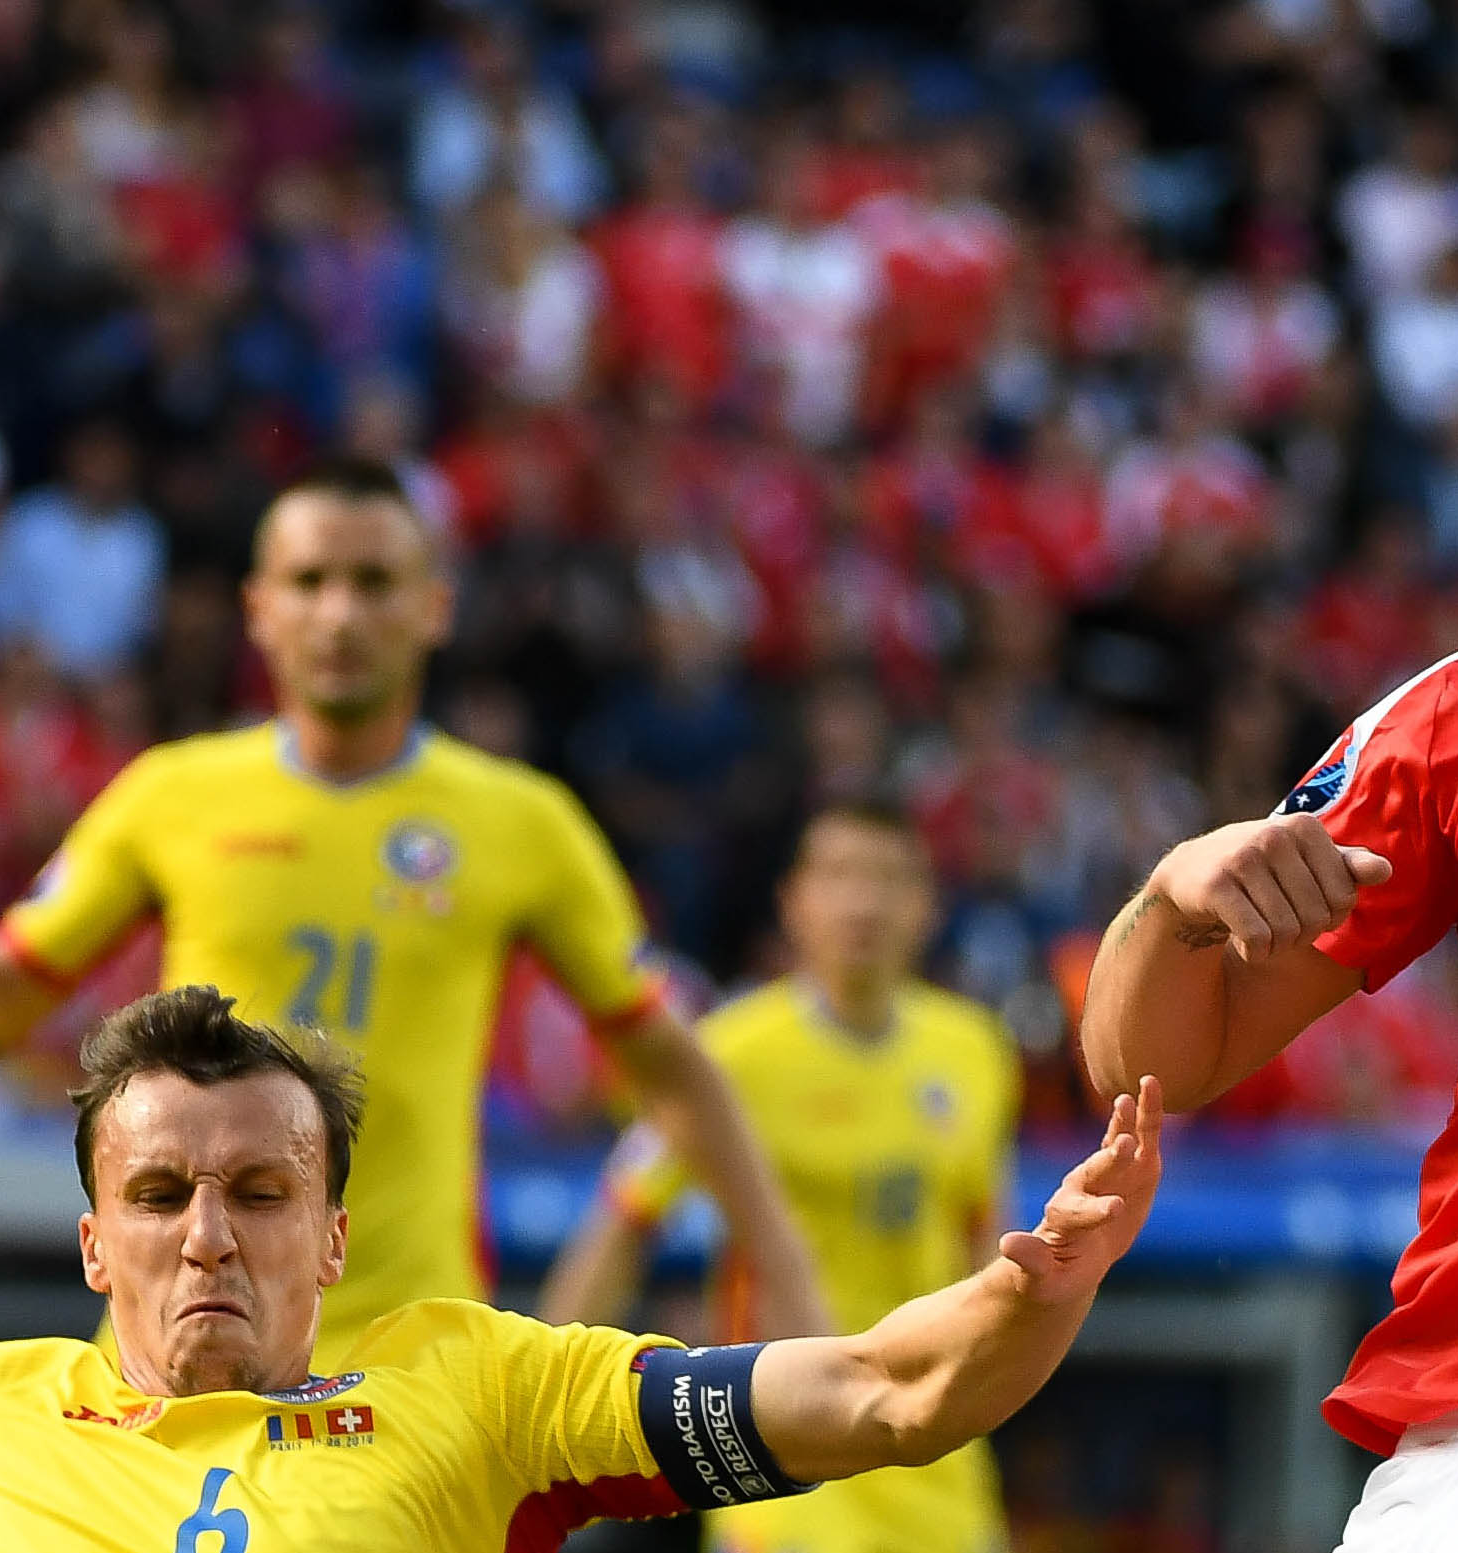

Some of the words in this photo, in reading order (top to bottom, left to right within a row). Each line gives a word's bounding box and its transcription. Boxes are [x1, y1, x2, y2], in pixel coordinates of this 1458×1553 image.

[284, 925, 378, 1030] 21
[672, 1374, 705, 1457] RACISM
[707, 1385, 753, 1473] RESPECT
[695, 1460, 720, 1485] TO
